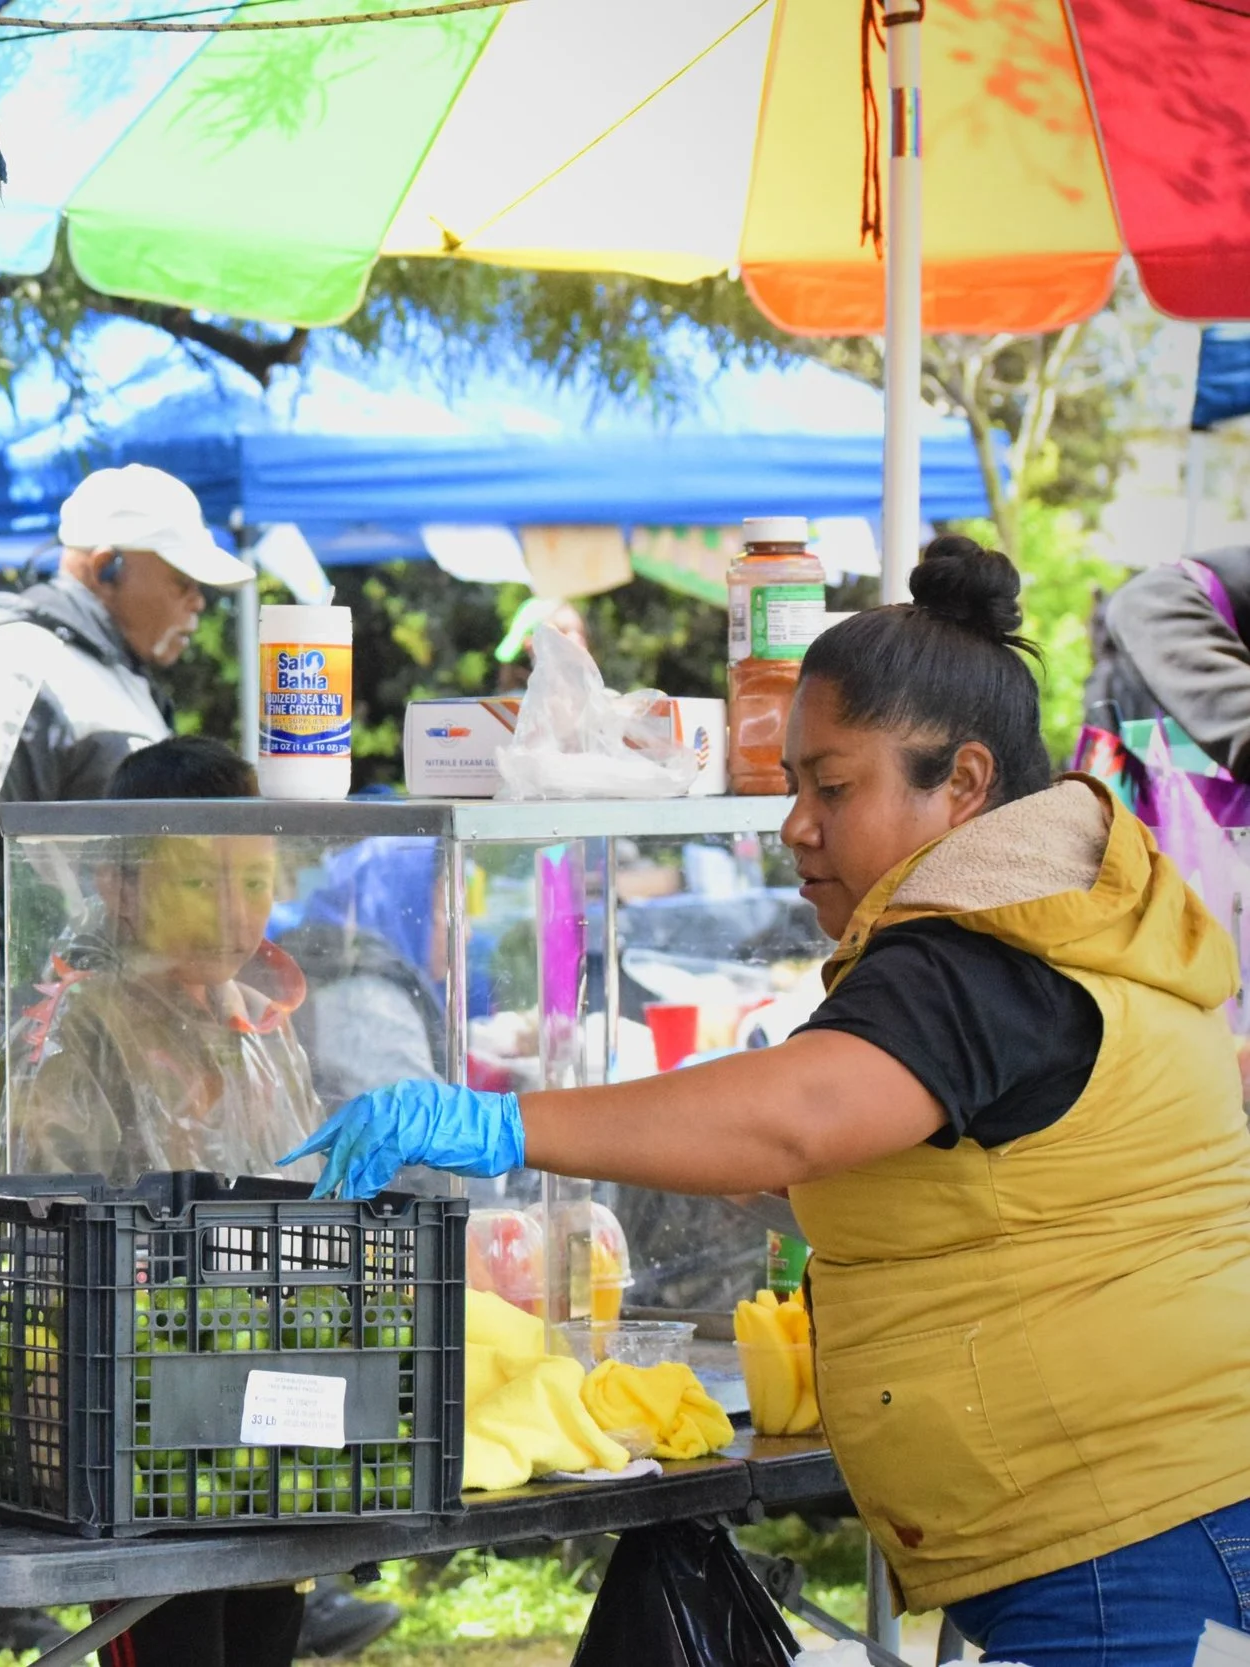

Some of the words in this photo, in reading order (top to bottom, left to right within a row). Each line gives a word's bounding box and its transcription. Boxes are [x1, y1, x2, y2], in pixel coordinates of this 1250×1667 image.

[278, 652, 305, 670] Sal
[278, 672, 327, 689] Bahía
[300, 693, 319, 704] SEA
[321, 694, 342, 705] SALT
[268, 704, 287, 715] FINE
[289, 704, 337, 715] CRYSTALS
[280, 743, 291, 751] OZ
[302, 743, 314, 752] LB
[316, 743, 325, 752] 10
[425, 759, 457, 767] NITRILE
[459, 759, 483, 767] EXAM
[251, 1414, 262, 1425] 33
[266, 1415, 277, 1426] Lb
